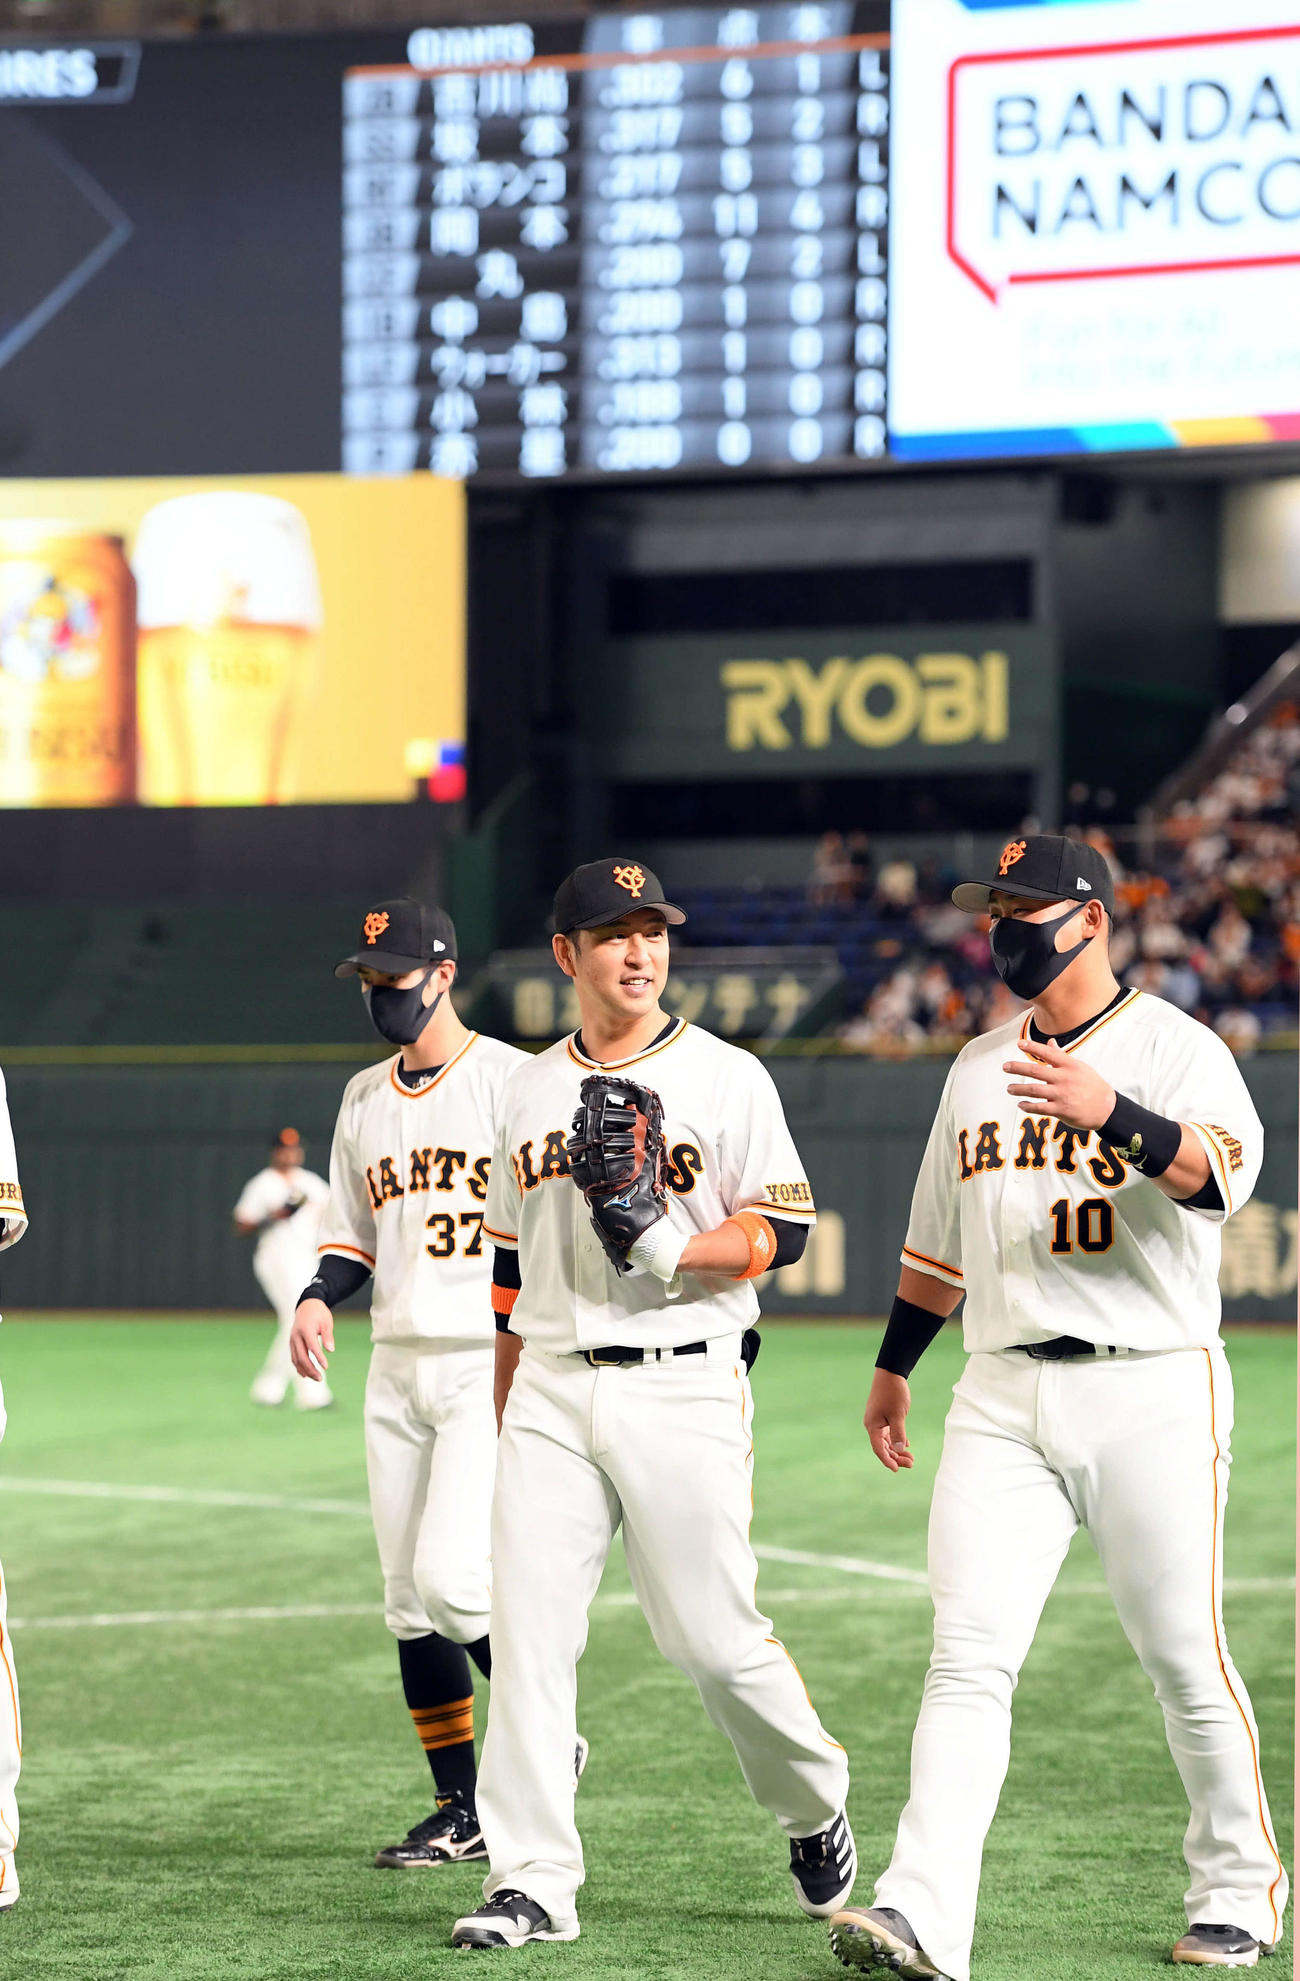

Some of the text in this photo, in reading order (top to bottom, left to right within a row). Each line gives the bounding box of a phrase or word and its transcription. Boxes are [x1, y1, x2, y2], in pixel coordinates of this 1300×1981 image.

[993, 75, 1293, 157] BANDA
[720, 650, 1010, 752] RYOBI
[425, 1212, 485, 1259] 37
[1050, 1197, 1114, 1255] 10
